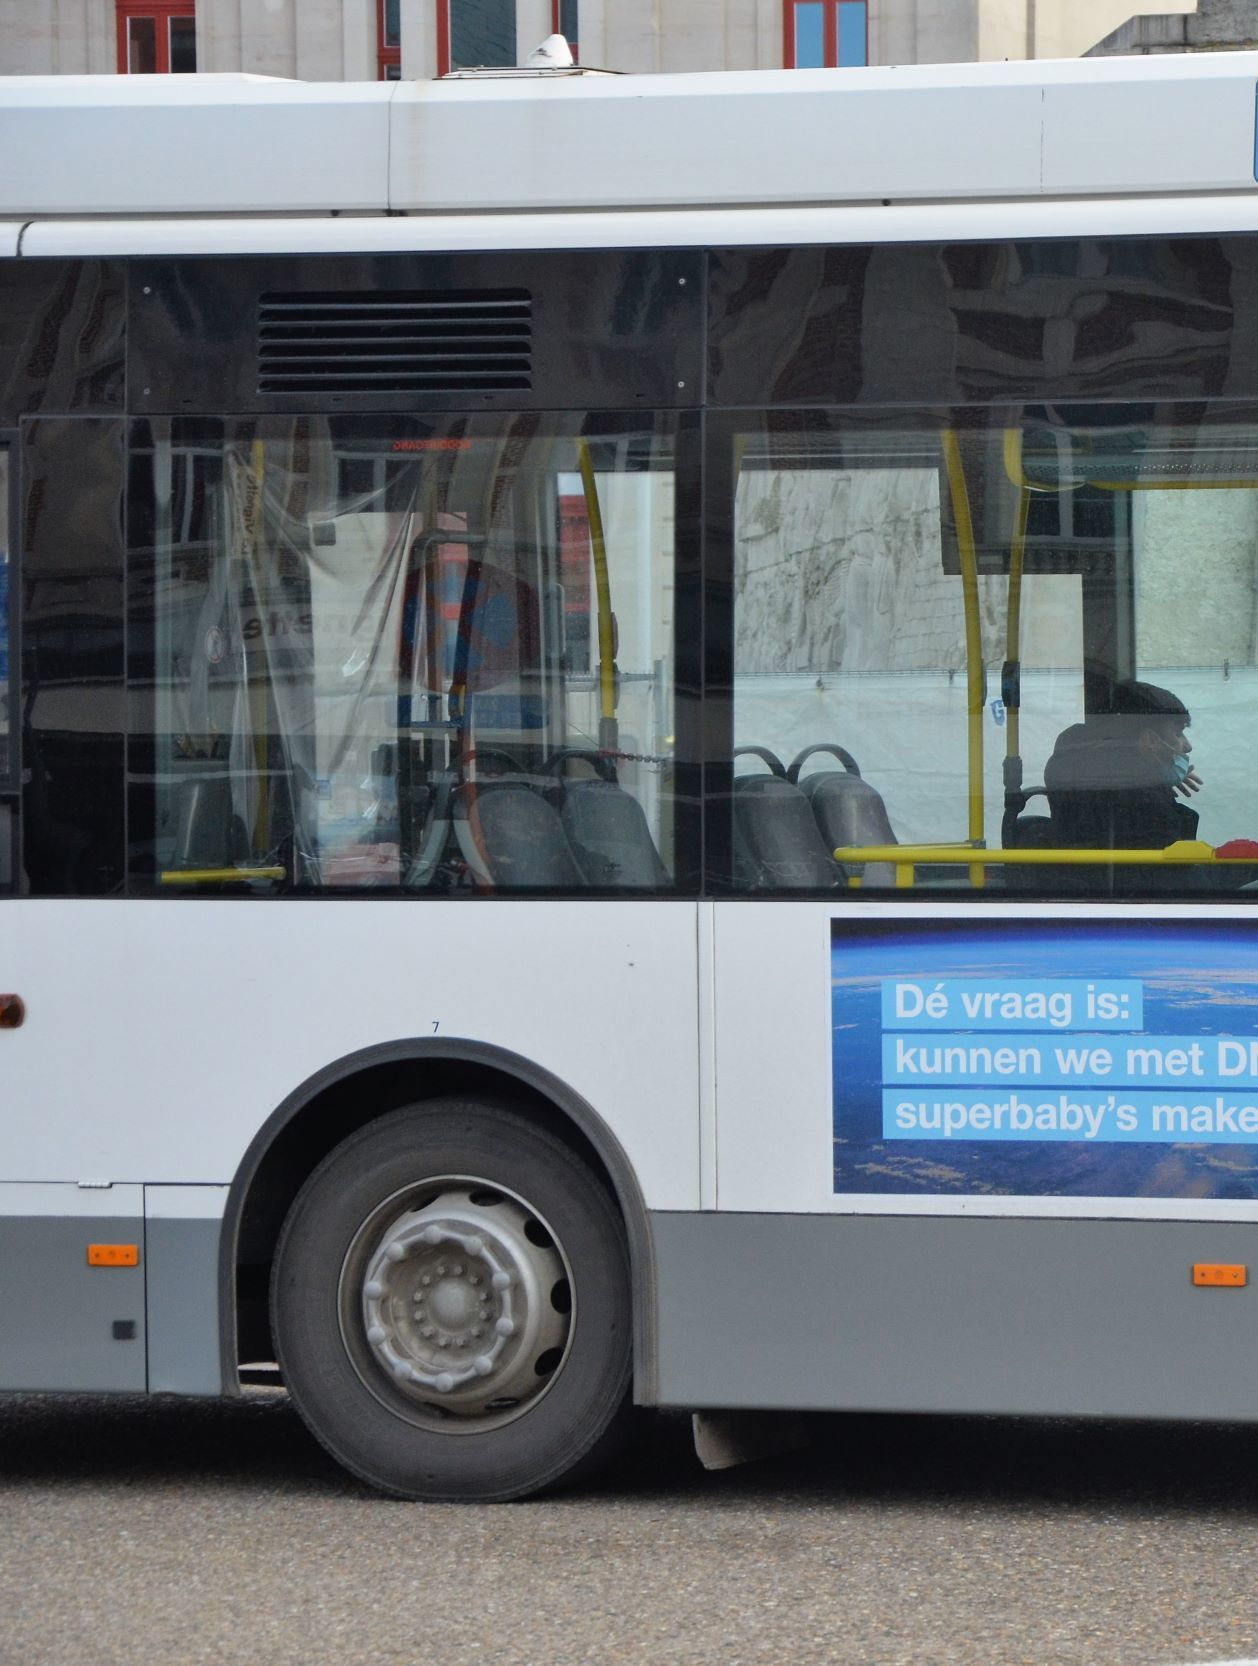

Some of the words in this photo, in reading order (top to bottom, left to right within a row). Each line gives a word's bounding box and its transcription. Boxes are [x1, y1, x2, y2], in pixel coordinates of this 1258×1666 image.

[895, 983, 949, 1019] Dé
[960, 992, 1073, 1028] vraag
[1086, 984, 1130, 1020] is:
[431, 1021, 440, 1033] 7
[895, 1039, 1042, 1075] kunnen
[1054, 1046, 1113, 1076] we
[1127, 1042, 1204, 1077] met
[895, 1094, 1138, 1138] superbaby’s
